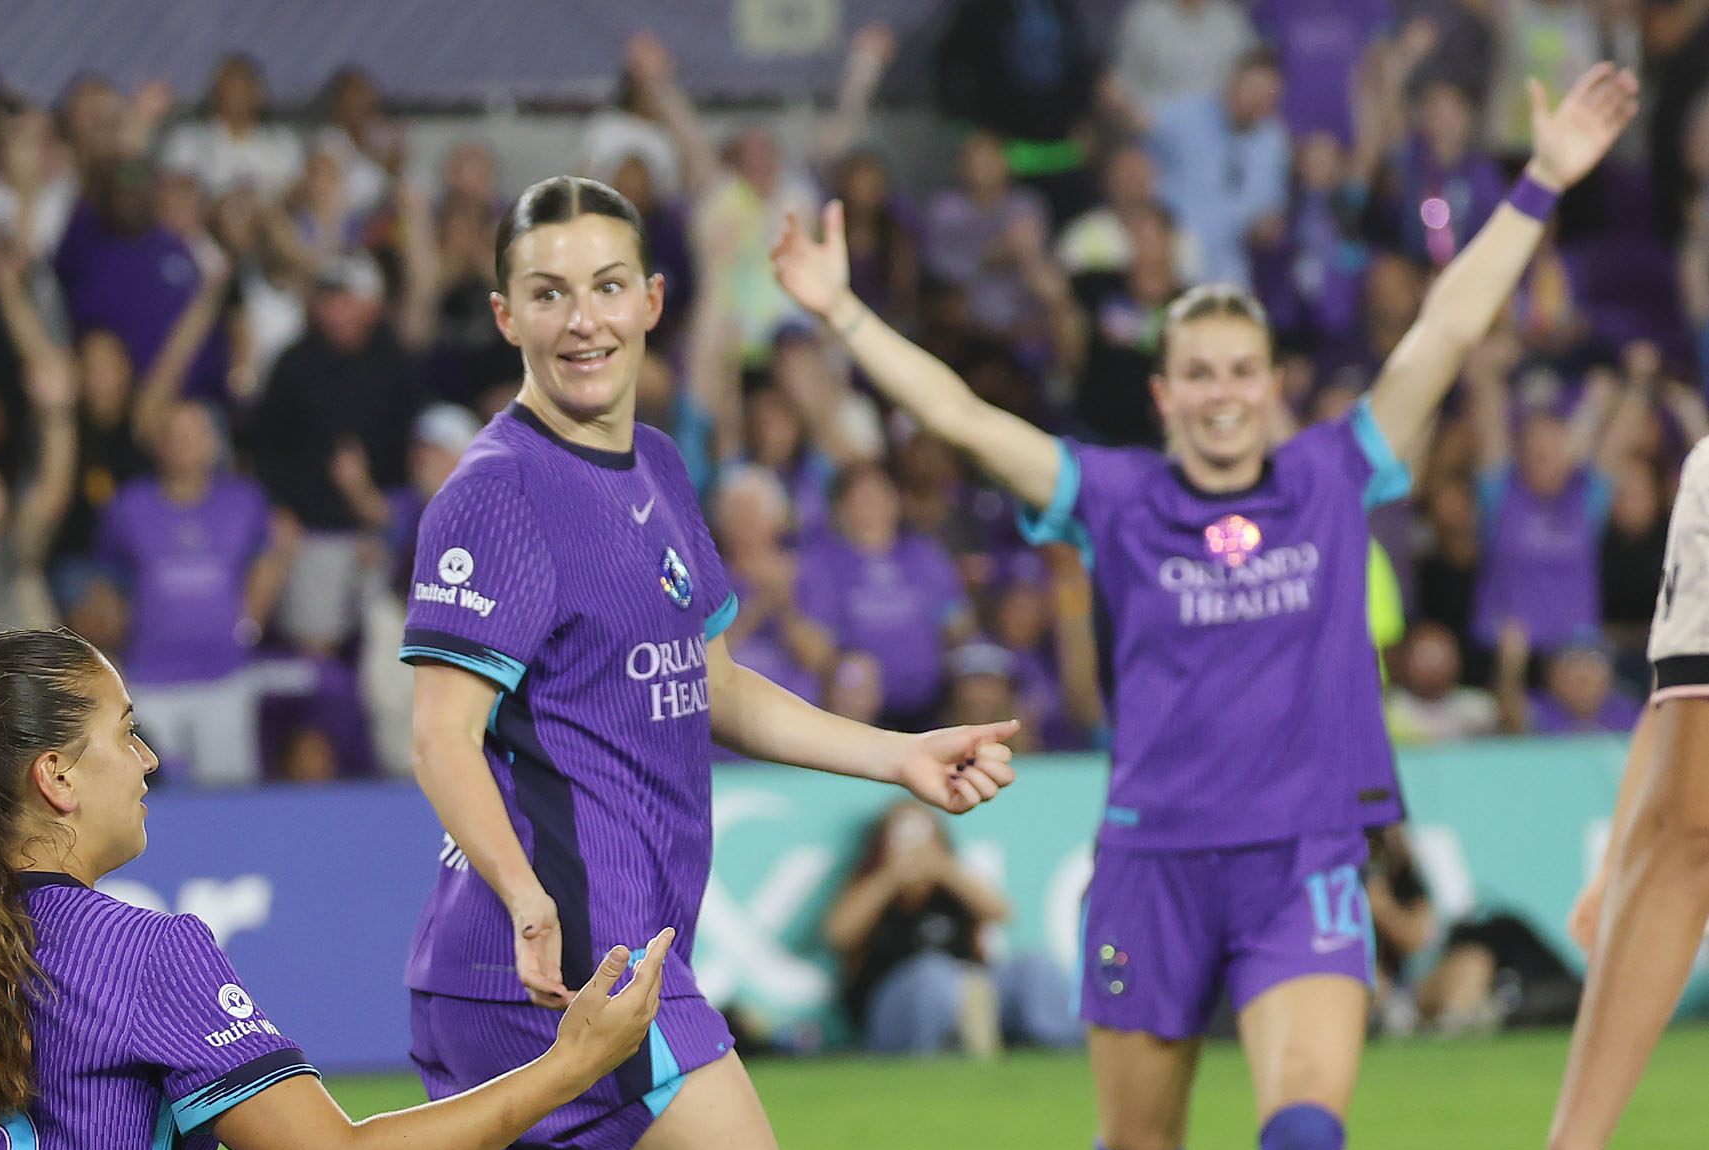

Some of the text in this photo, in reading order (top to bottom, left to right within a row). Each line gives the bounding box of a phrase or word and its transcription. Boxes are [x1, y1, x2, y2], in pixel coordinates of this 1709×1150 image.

[415, 583, 496, 617] United Way
[1179, 576, 1310, 626] HEALTH
[626, 632, 707, 680] ORLAN
[650, 677, 709, 721] HEAL
[1305, 866, 1361, 937] 12
